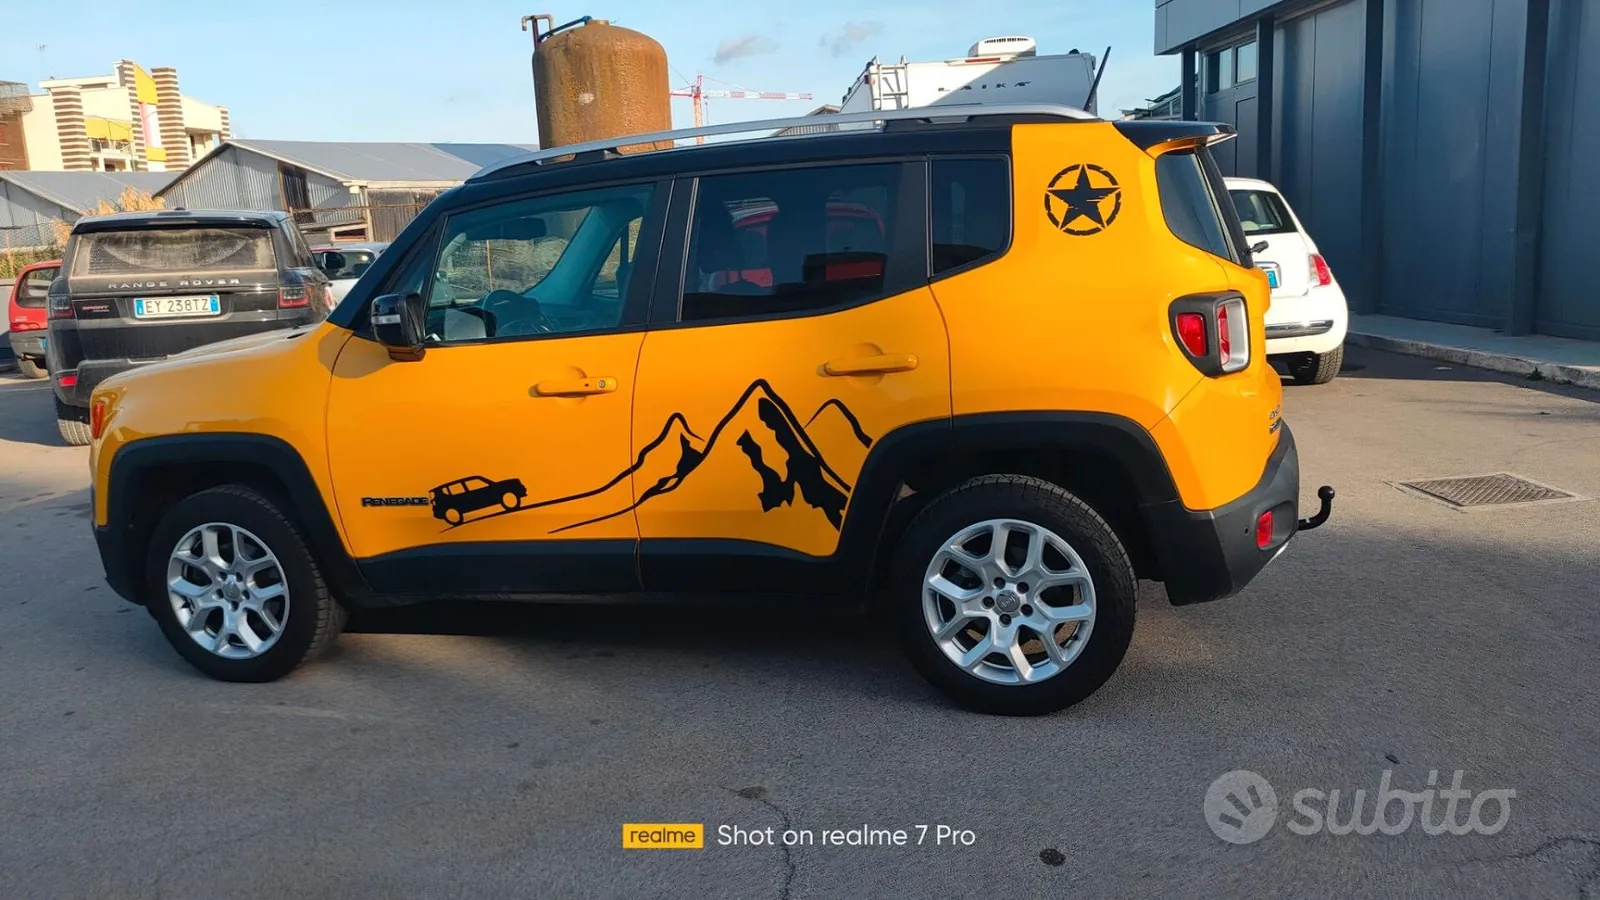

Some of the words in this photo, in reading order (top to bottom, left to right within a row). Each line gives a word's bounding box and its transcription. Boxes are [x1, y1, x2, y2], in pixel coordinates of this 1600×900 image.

[108, 281, 168, 289] RANGE
[180, 278, 240, 286] ROVER
[145, 300, 165, 314] EY
[167, 298, 209, 313] 238TZ
[361, 497, 429, 507] RENEGADE
